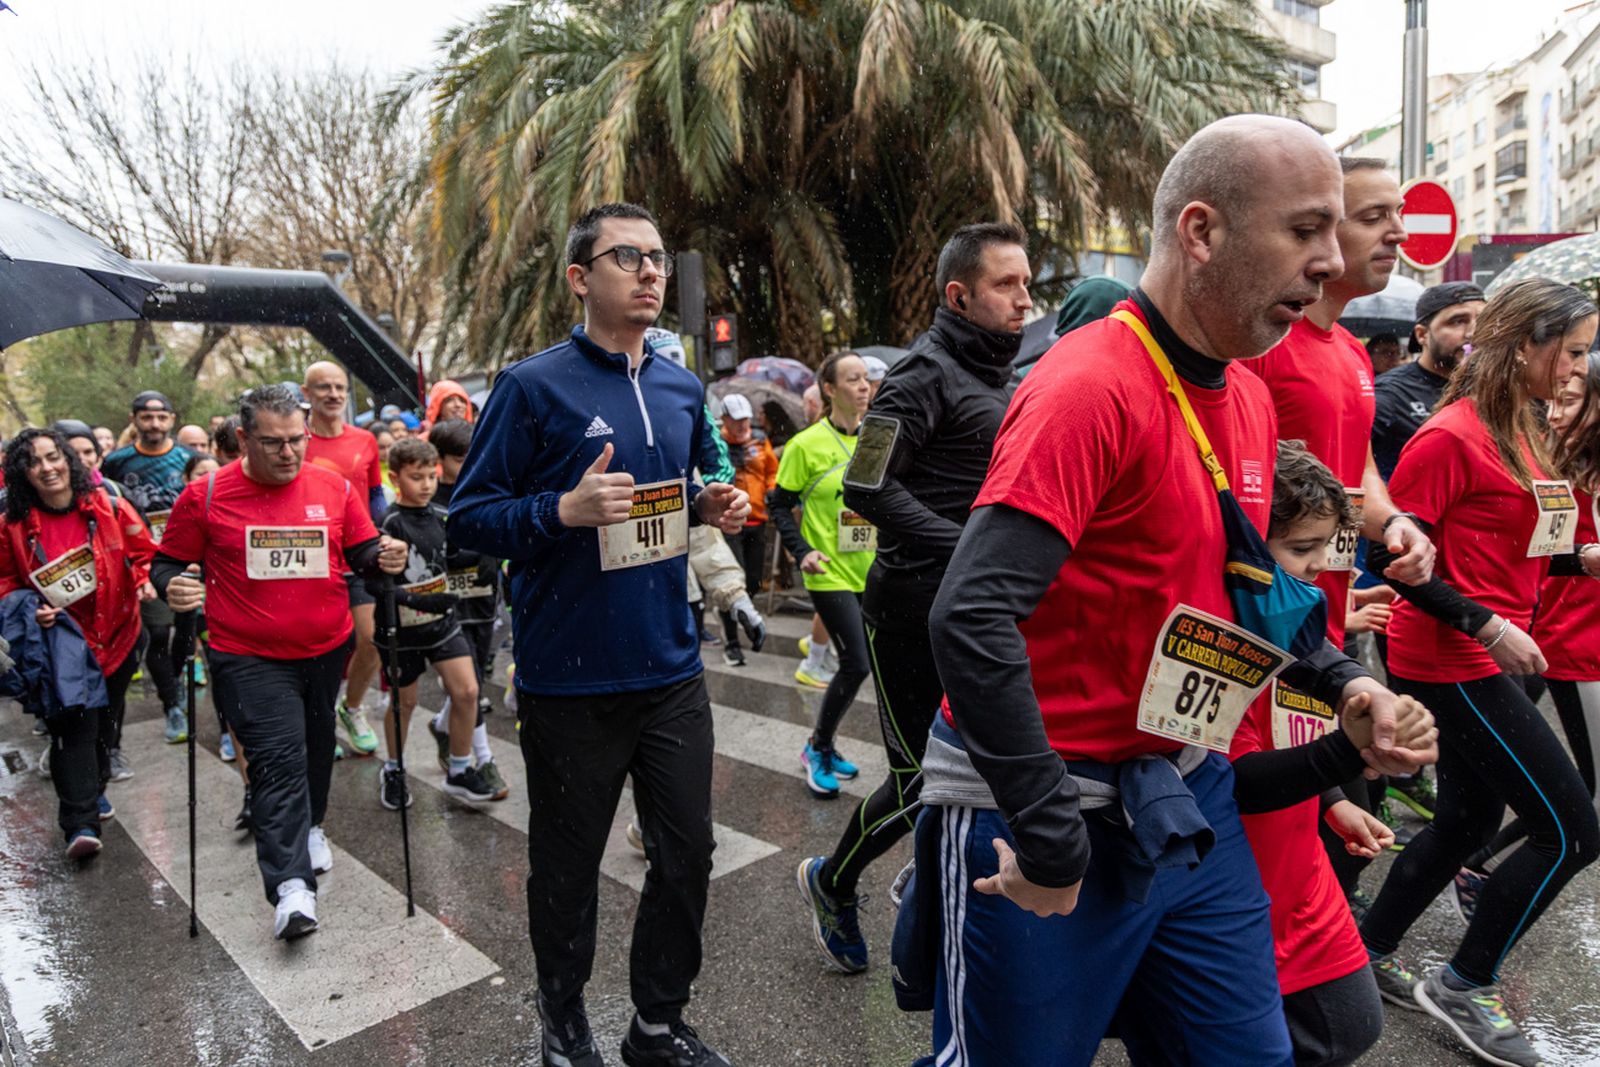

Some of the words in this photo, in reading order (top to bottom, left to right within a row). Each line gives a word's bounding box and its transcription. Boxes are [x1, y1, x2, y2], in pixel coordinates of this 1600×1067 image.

[584, 427, 614, 438] adidas
[643, 491, 661, 501] Juan
[661, 486, 679, 498] Bosco
[655, 497, 682, 513] POPULAR
[637, 517, 665, 548] 411
[852, 527, 872, 542] 897
[270, 549, 307, 568] 874
[61, 568, 93, 592] 876
[448, 575, 475, 590] 385
[1175, 617, 1194, 636] IES
[1194, 623, 1215, 644] San
[1214, 632, 1239, 651] Juan
[1237, 643, 1273, 667] Bosco
[1167, 634, 1178, 653] V
[1176, 639, 1221, 671] CARRERA
[1220, 654, 1264, 685] POPULAR
[1175, 670, 1228, 724] 875
